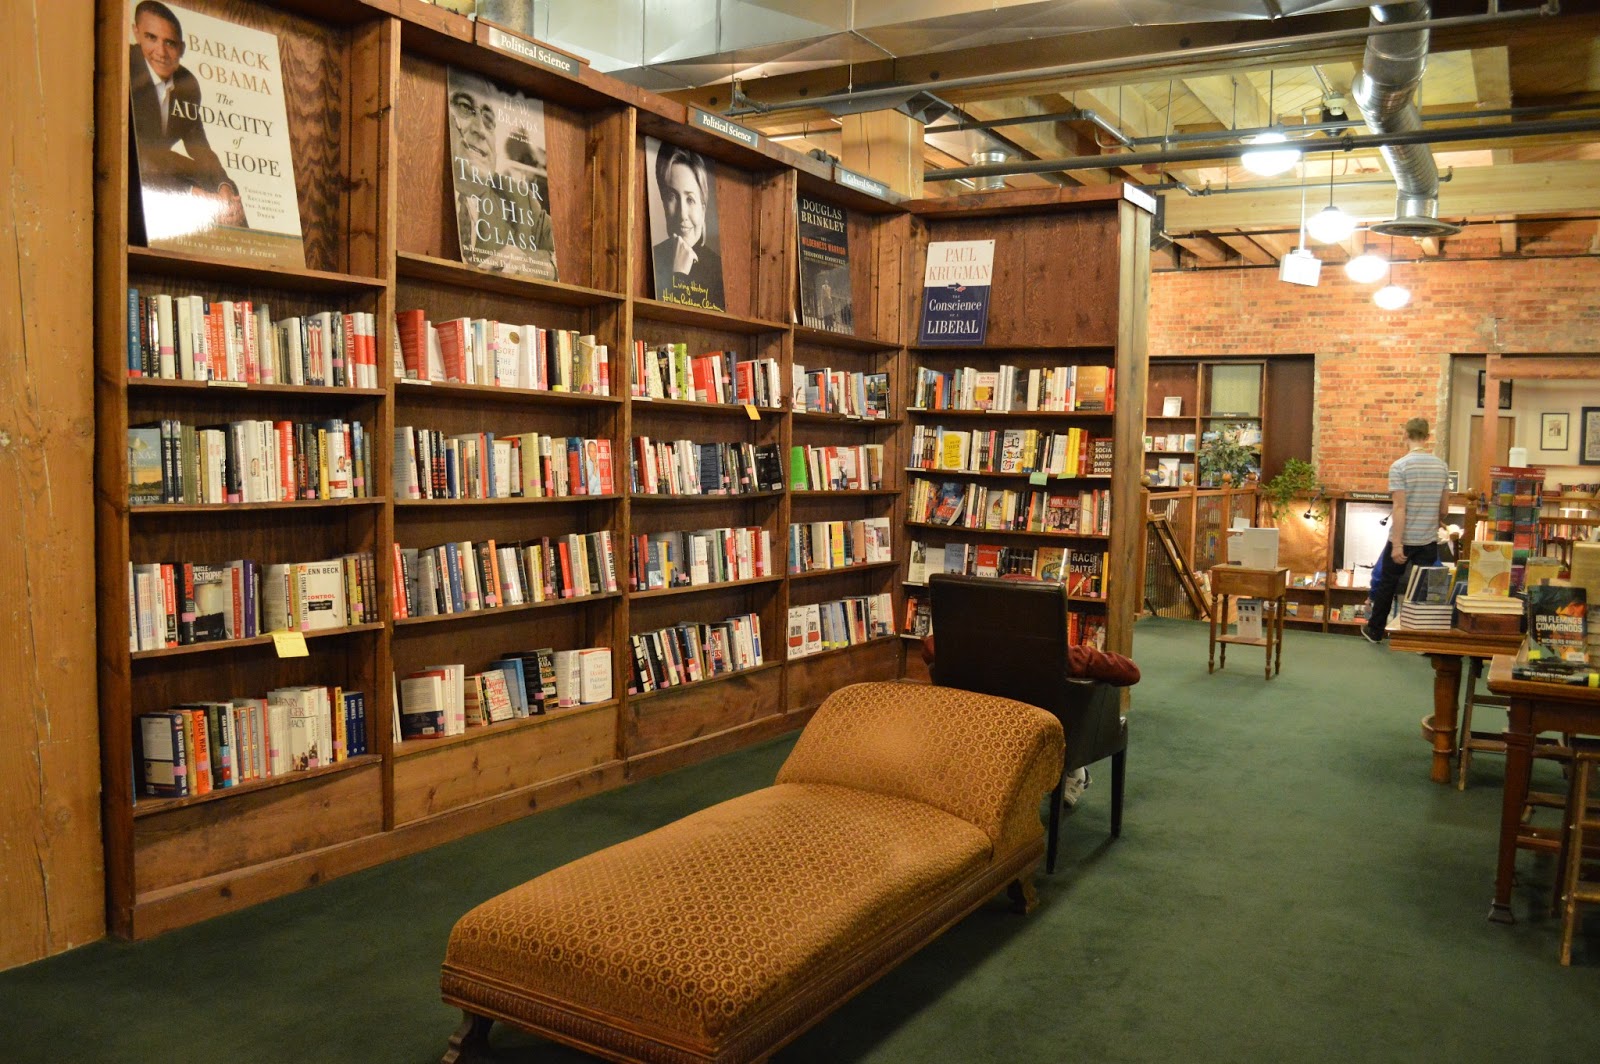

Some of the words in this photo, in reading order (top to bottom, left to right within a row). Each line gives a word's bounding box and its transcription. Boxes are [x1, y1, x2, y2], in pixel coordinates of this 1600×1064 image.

[188, 34, 271, 71] BARACK
[500, 34, 538, 59] Political
[538, 50, 571, 72] Science
[198, 63, 273, 96] OBAMA
[216, 92, 234, 106] The
[171, 98, 273, 137] AUDACITY
[498, 108, 538, 132] BRANDS
[702, 114, 728, 134] Political
[728, 124, 752, 143] Science
[233, 136, 244, 149] of
[225, 151, 282, 178] HOPE
[455, 156, 544, 202] TRAITOR
[471, 194, 494, 216] TO
[500, 198, 535, 228] HIS
[803, 198, 842, 220] DOUGLAS
[801, 211, 845, 233] BRINKLEY
[475, 218, 537, 252] CLASS
[945, 247, 977, 263] PAUL
[929, 264, 991, 281] KRUGMAN
[929, 298, 982, 312] Conscience
[345, 319, 355, 353] ANARCHY!
[927, 320, 979, 334] LIBERAL
[165, 440, 171, 448] AT
[175, 440, 181, 448] AT
[1050, 498, 1080, 506] WAL-MA
[184, 563, 194, 600] CHENEY
[193, 570, 223, 581] ASTROPHE
[1535, 623, 1583, 633] COMMANDOS
[1536, 614, 1547, 622] IAN
[197, 714, 205, 737] CYBER
[178, 751, 185, 759] OF
[199, 738, 207, 754] WAR
[179, 758, 187, 788] COTION
